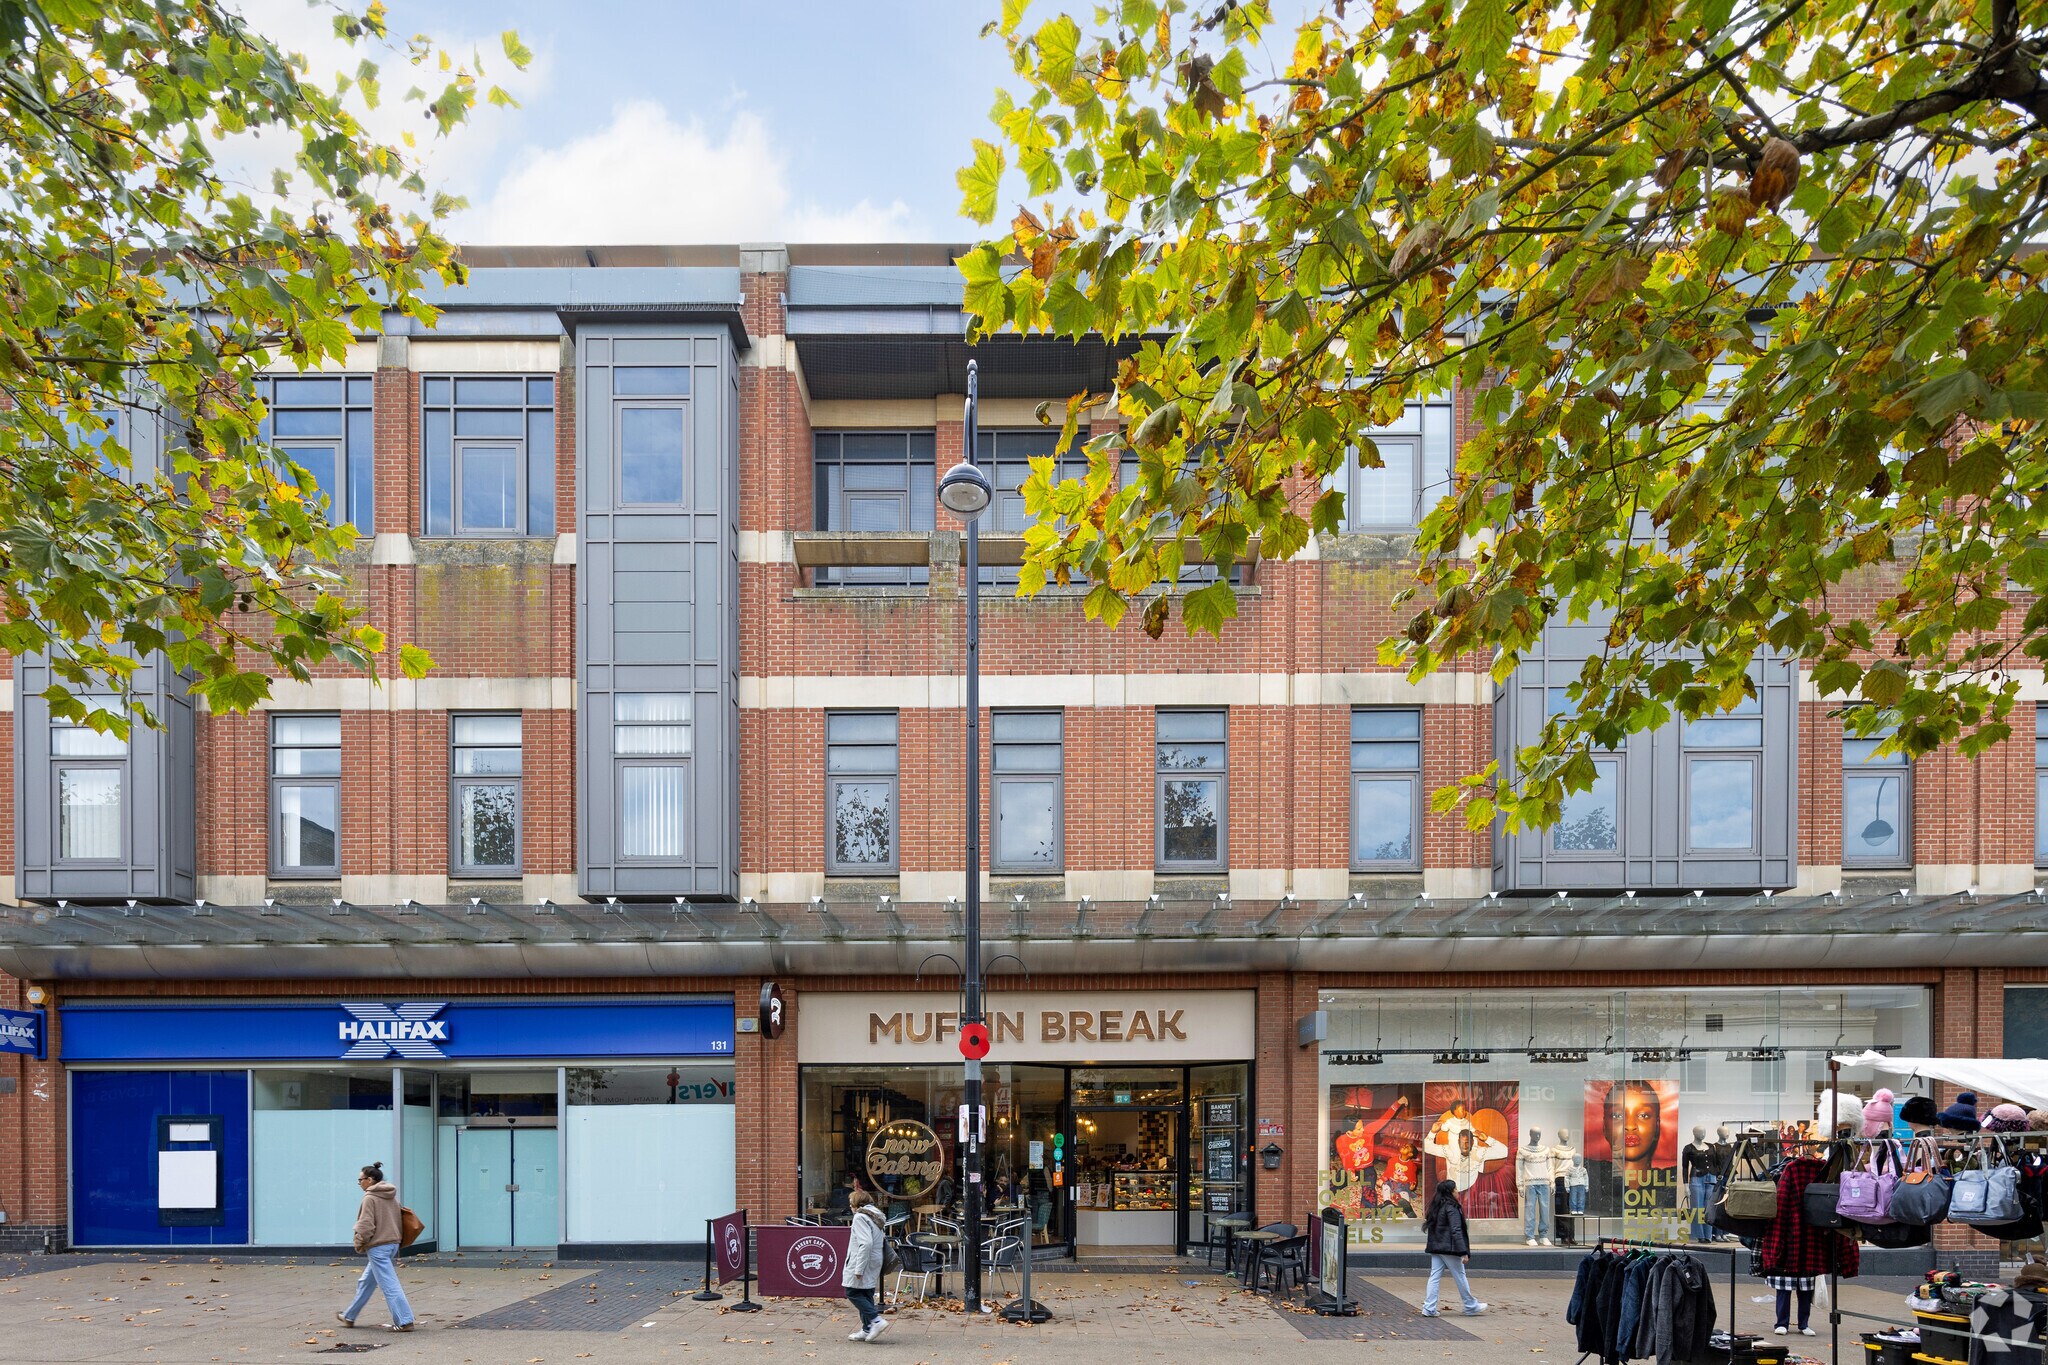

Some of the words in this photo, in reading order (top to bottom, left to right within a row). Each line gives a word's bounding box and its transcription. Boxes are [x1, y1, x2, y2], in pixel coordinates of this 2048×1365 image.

[339, 1021, 447, 1040] HALIFAX
[869, 1011, 1024, 1043] MUFIN
[1041, 1009, 1187, 1042] BREAK
[711, 1041, 727, 1050] 131
[869, 1154, 941, 1182] Baking
[1318, 1169, 1372, 1187] FULL
[1624, 1169, 1678, 1187] FULL
[1318, 1189, 1352, 1206] ON
[1624, 1189, 1656, 1206] ON
[1319, 1207, 1404, 1225] STIVE
[1624, 1207, 1706, 1225] FESTIVE
[1347, 1227, 1384, 1244] ELS
[1624, 1227, 1690, 1244] FEELS
